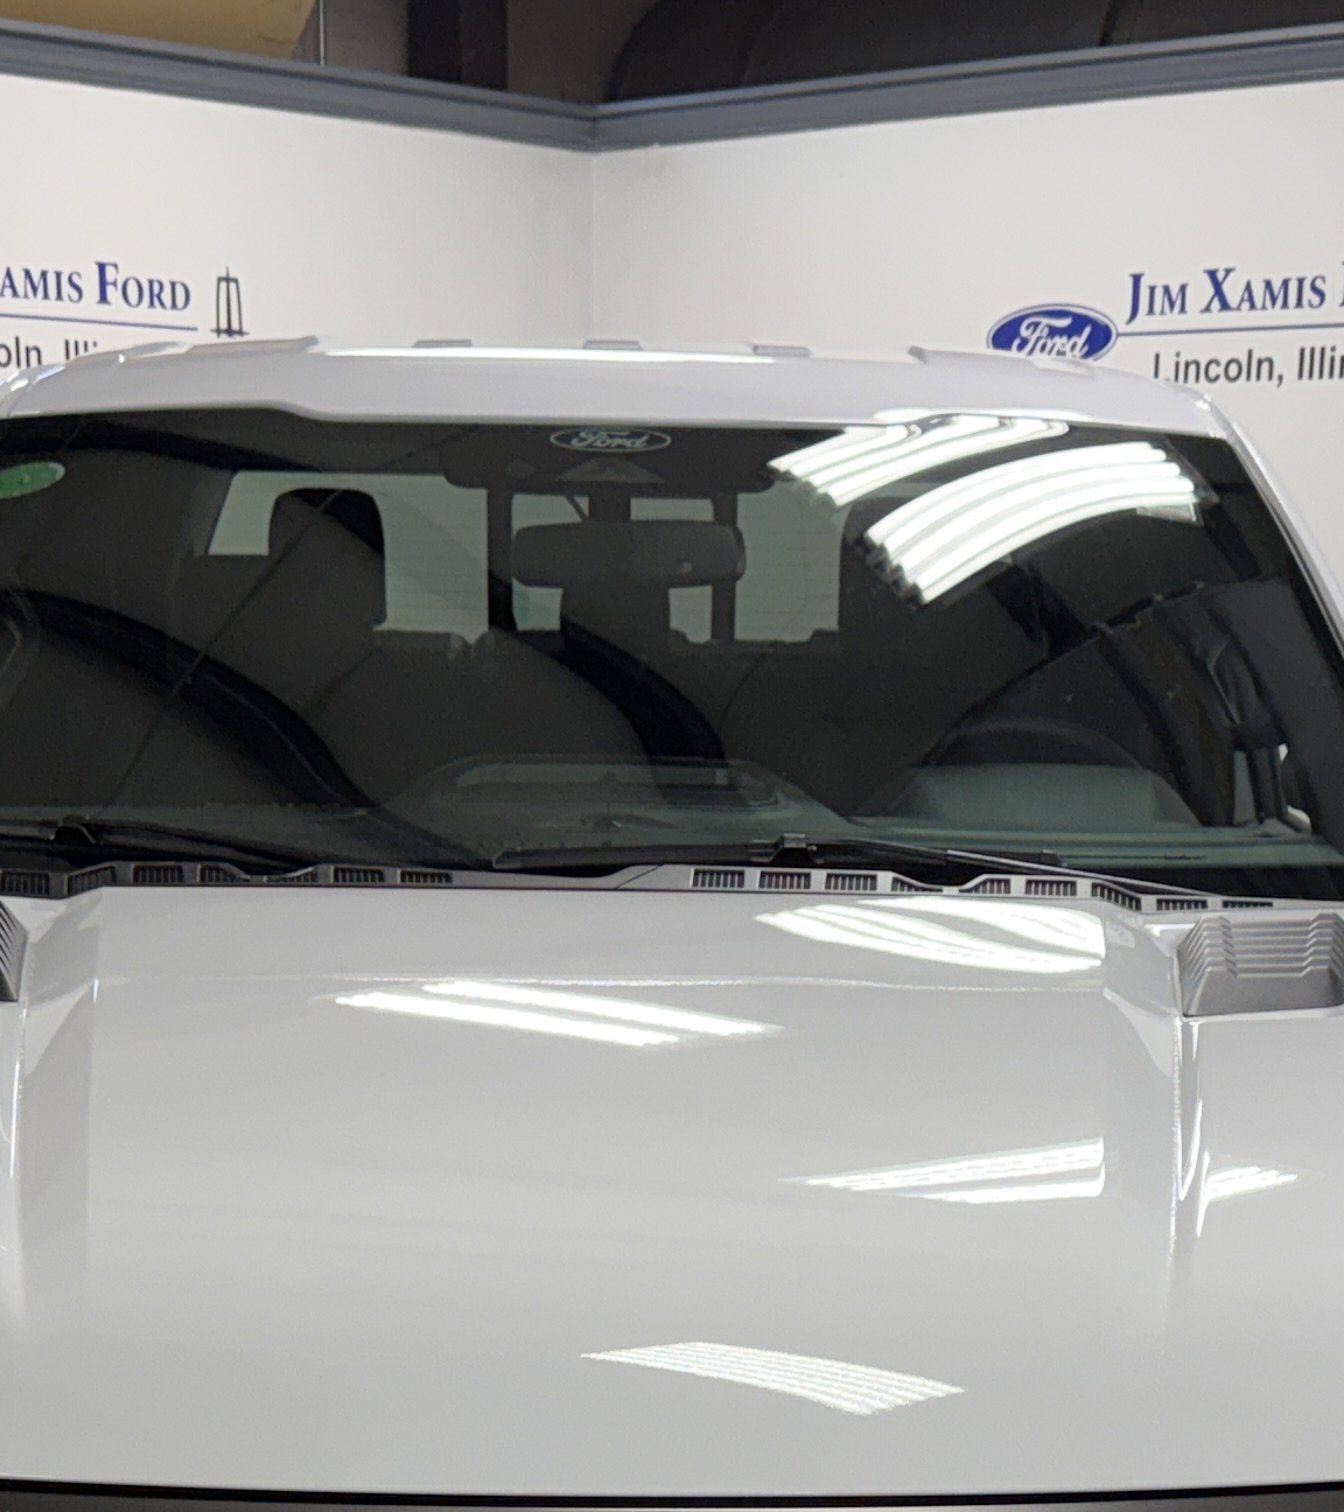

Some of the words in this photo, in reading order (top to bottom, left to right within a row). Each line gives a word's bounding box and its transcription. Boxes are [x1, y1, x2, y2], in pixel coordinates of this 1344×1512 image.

[95, 261, 192, 311] FORD
[1125, 272, 1189, 325] JIM
[1200, 267, 1326, 313] XAMIS
[1011, 316, 1092, 358] Ford
